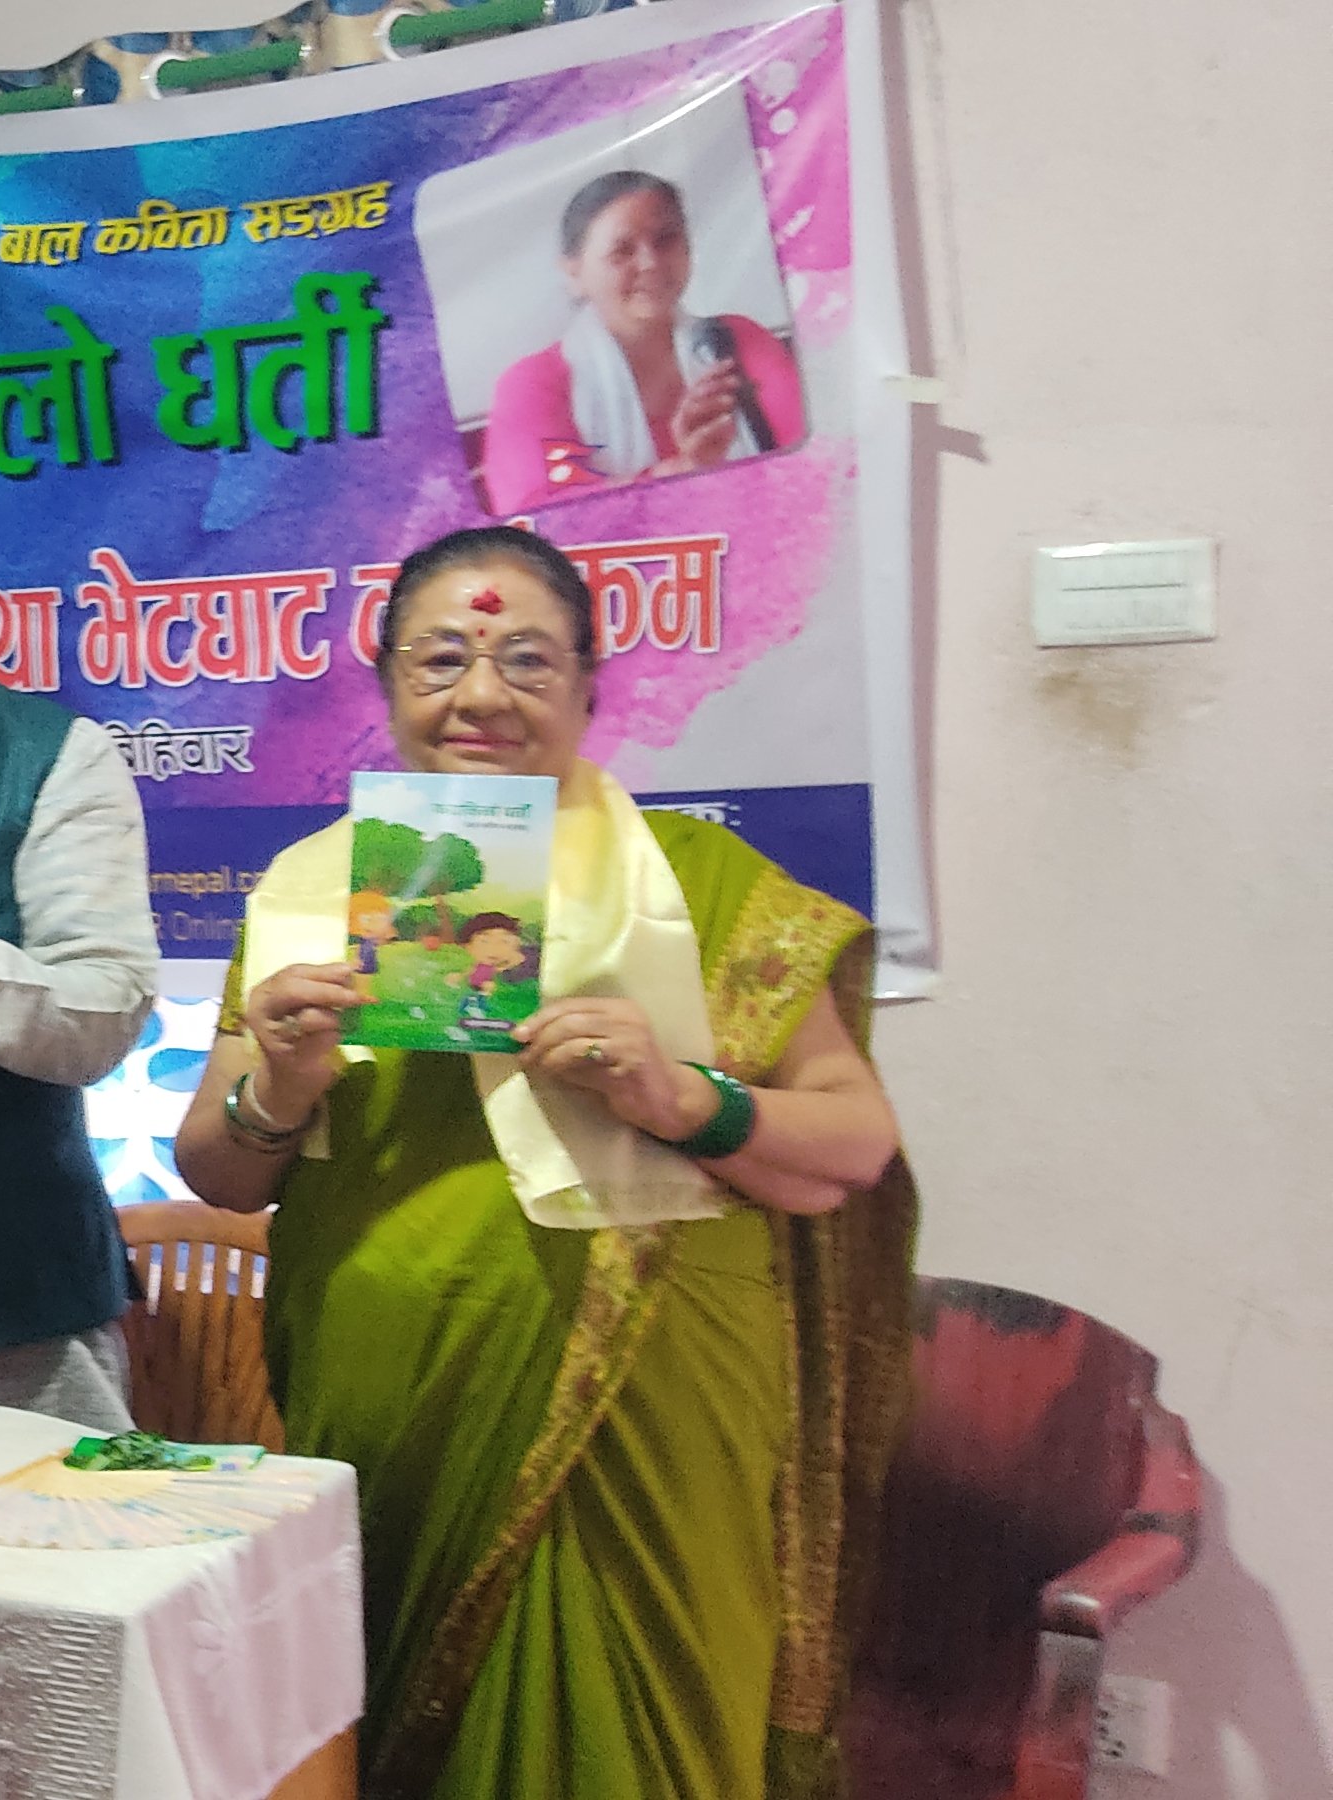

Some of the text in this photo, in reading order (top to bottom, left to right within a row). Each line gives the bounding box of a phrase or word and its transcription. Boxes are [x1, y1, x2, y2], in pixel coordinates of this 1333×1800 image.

[94, 198, 229, 255] कविता
[150, 271, 390, 452] धर्ती
[78, 548, 334, 688] भेटघाट
